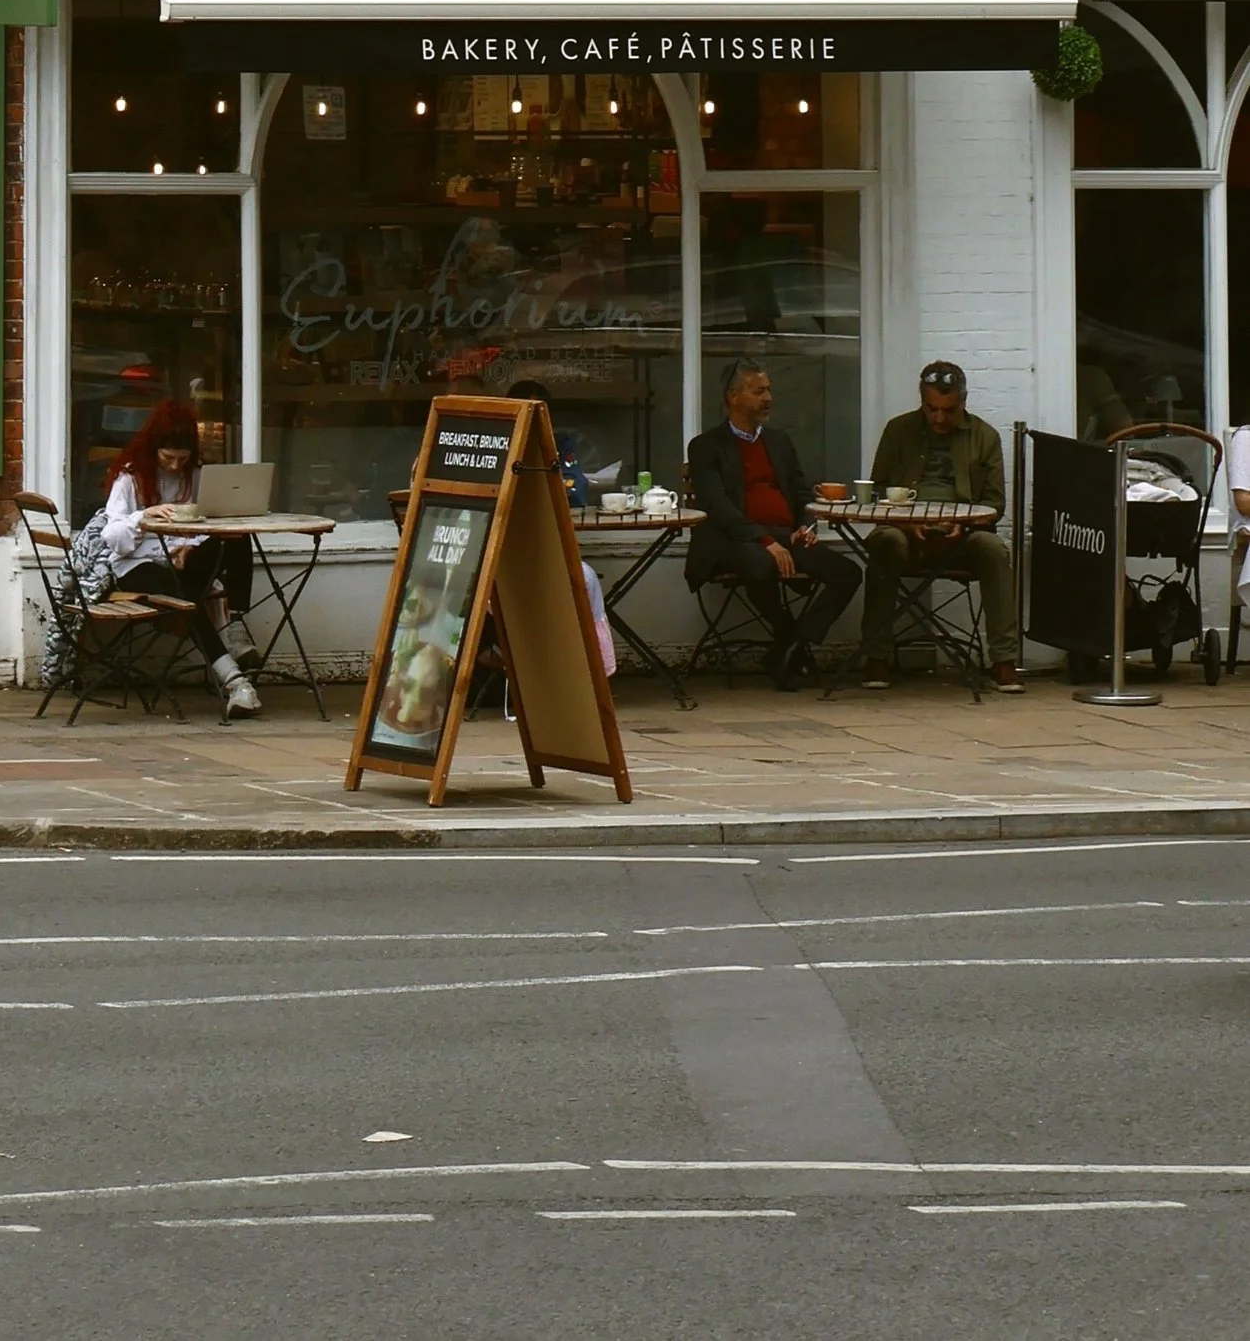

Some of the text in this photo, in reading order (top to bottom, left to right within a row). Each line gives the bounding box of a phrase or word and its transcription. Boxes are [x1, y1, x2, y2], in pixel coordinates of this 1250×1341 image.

[422, 30, 835, 64] BAKERY, CAFÉ, PÂTISSERIE
[438, 431, 480, 449] BREAKFAST,
[444, 452, 470, 467] LUNCH
[475, 454, 498, 469] LATER
[432, 525, 471, 545] BRUNCH
[1051, 509, 1106, 555] Mimmo
[426, 544, 467, 565] ALL DAY
